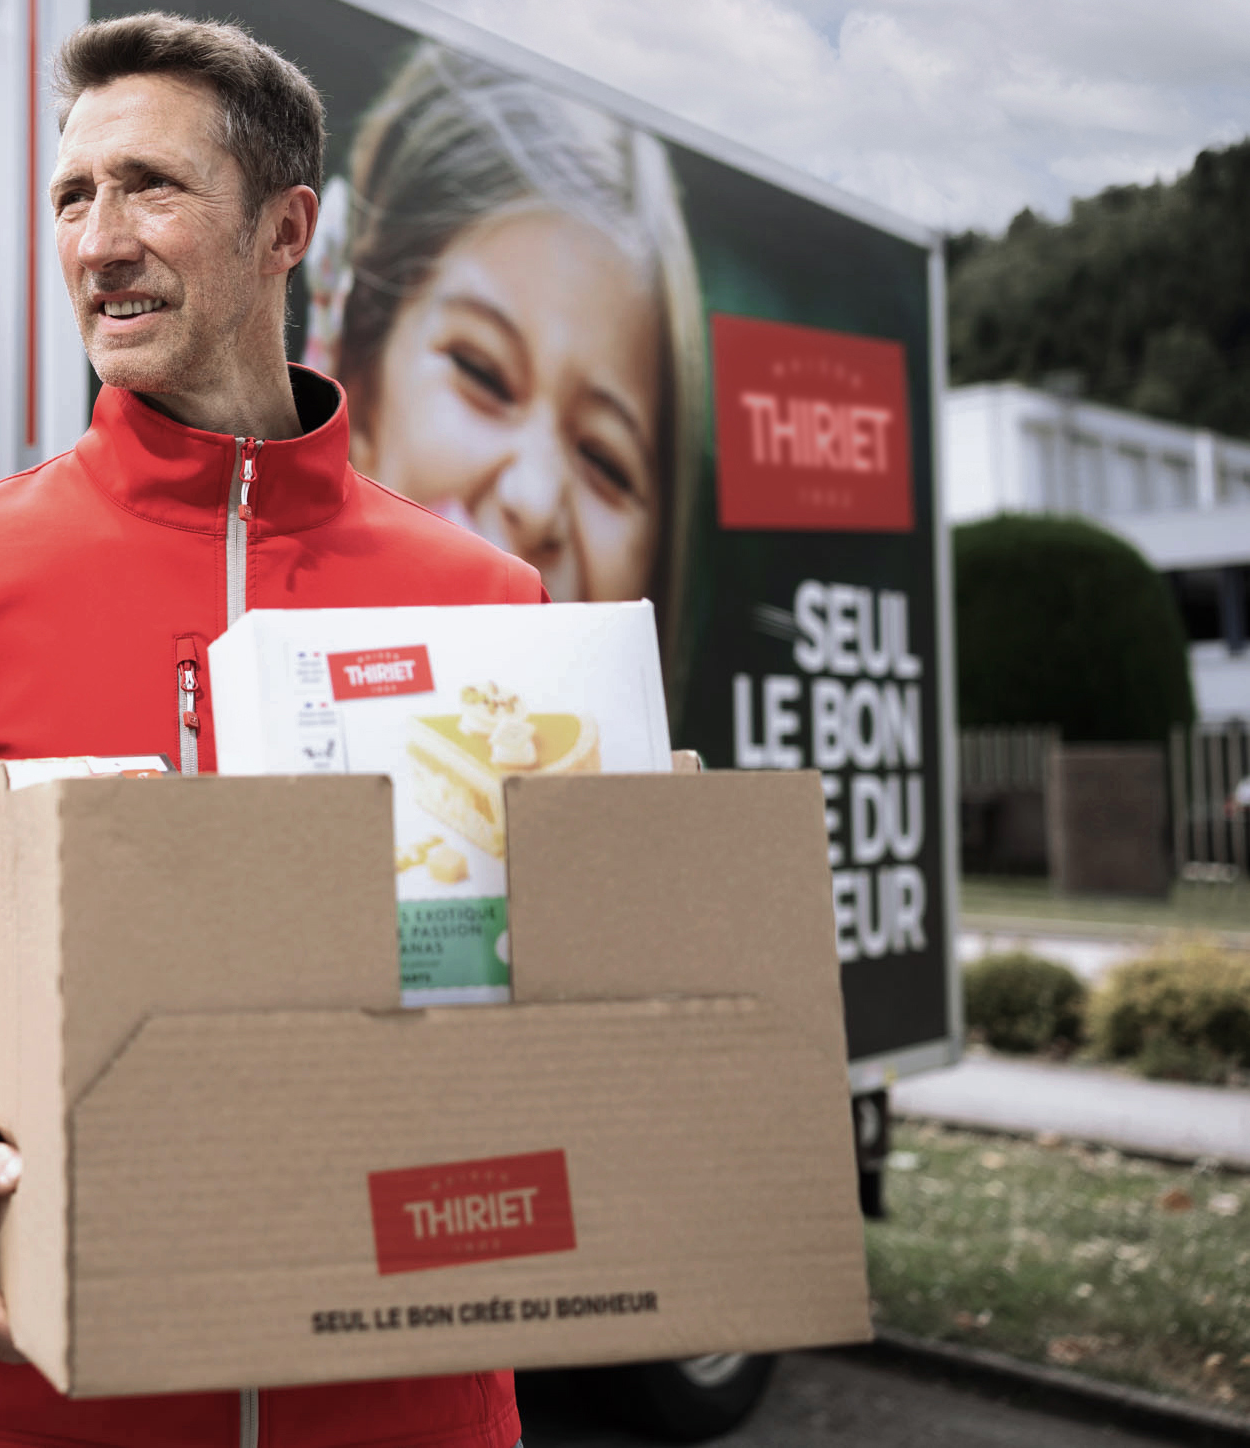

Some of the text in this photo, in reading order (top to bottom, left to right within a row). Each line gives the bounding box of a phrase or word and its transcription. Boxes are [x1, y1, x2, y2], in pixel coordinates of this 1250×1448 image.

[740, 392, 891, 473] THIRIET
[793, 579, 922, 679] SEUL
[343, 659, 416, 686] THIRIET
[733, 673, 923, 769] LE BON
[851, 772, 924, 864] DU
[832, 865, 928, 963] EUR
[403, 1186, 540, 1239] THIRIET
[311, 1290, 659, 1335] SEUL LE BON CRÉE DU BONHEUR
